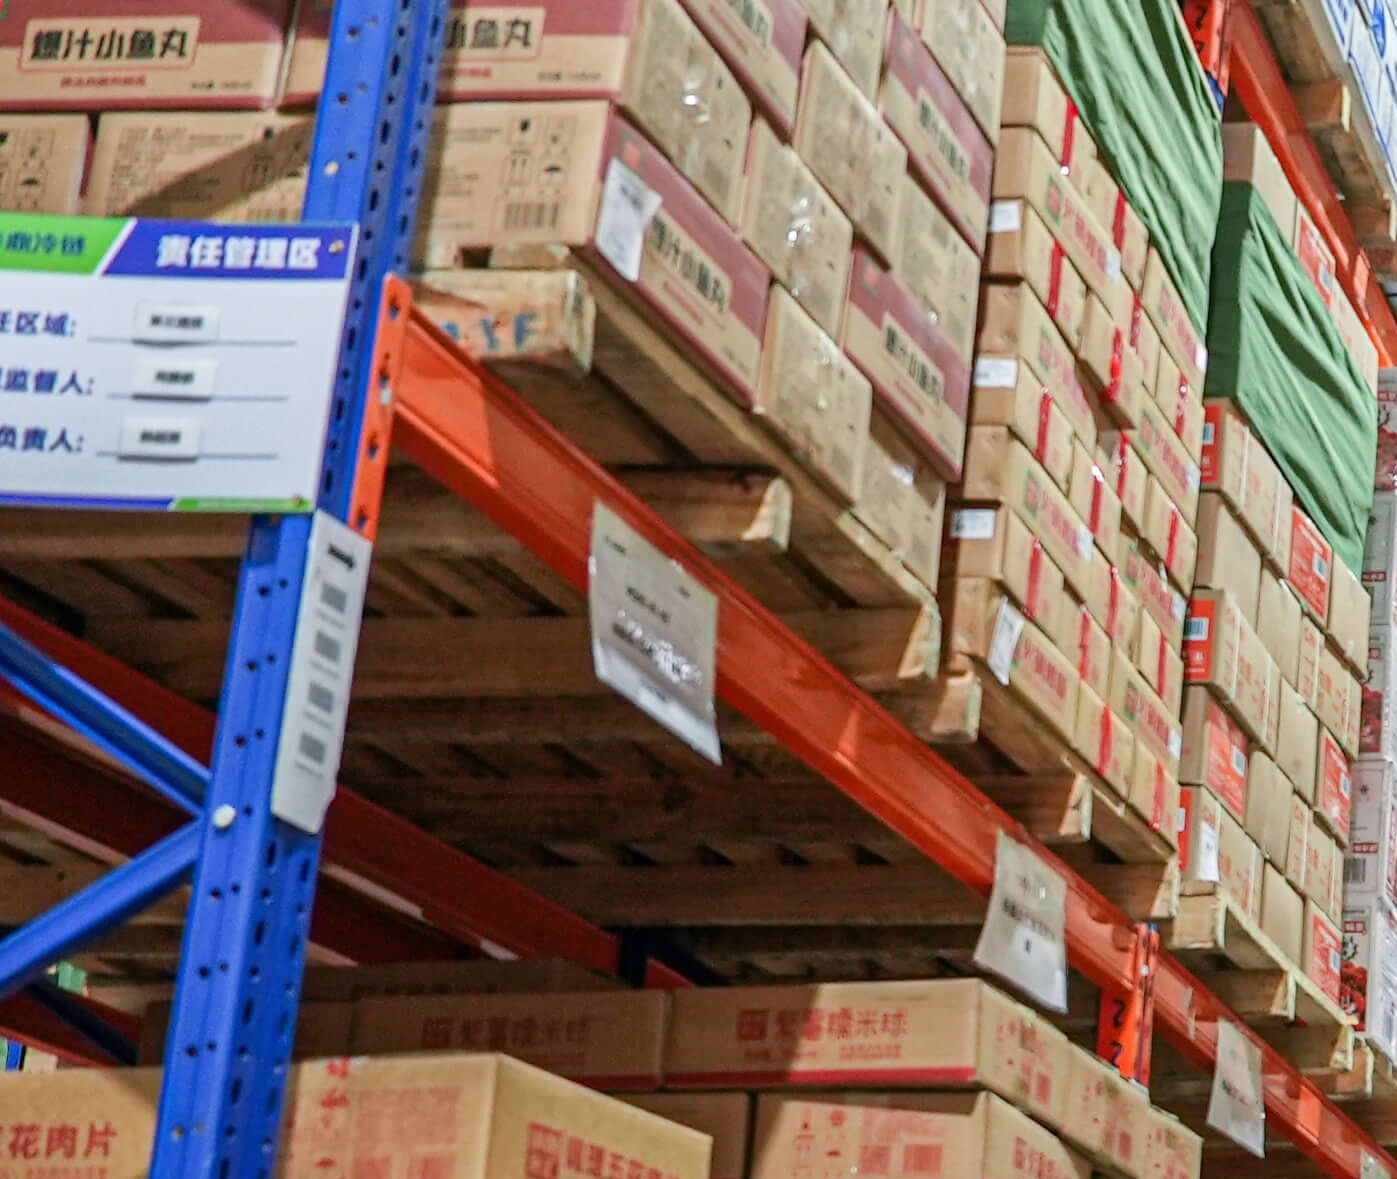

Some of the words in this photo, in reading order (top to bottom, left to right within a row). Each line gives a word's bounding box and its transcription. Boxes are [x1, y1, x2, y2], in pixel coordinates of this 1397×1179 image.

[157, 235, 322, 269] 责任管理区
[0, 369, 94, 396] 监督人：
